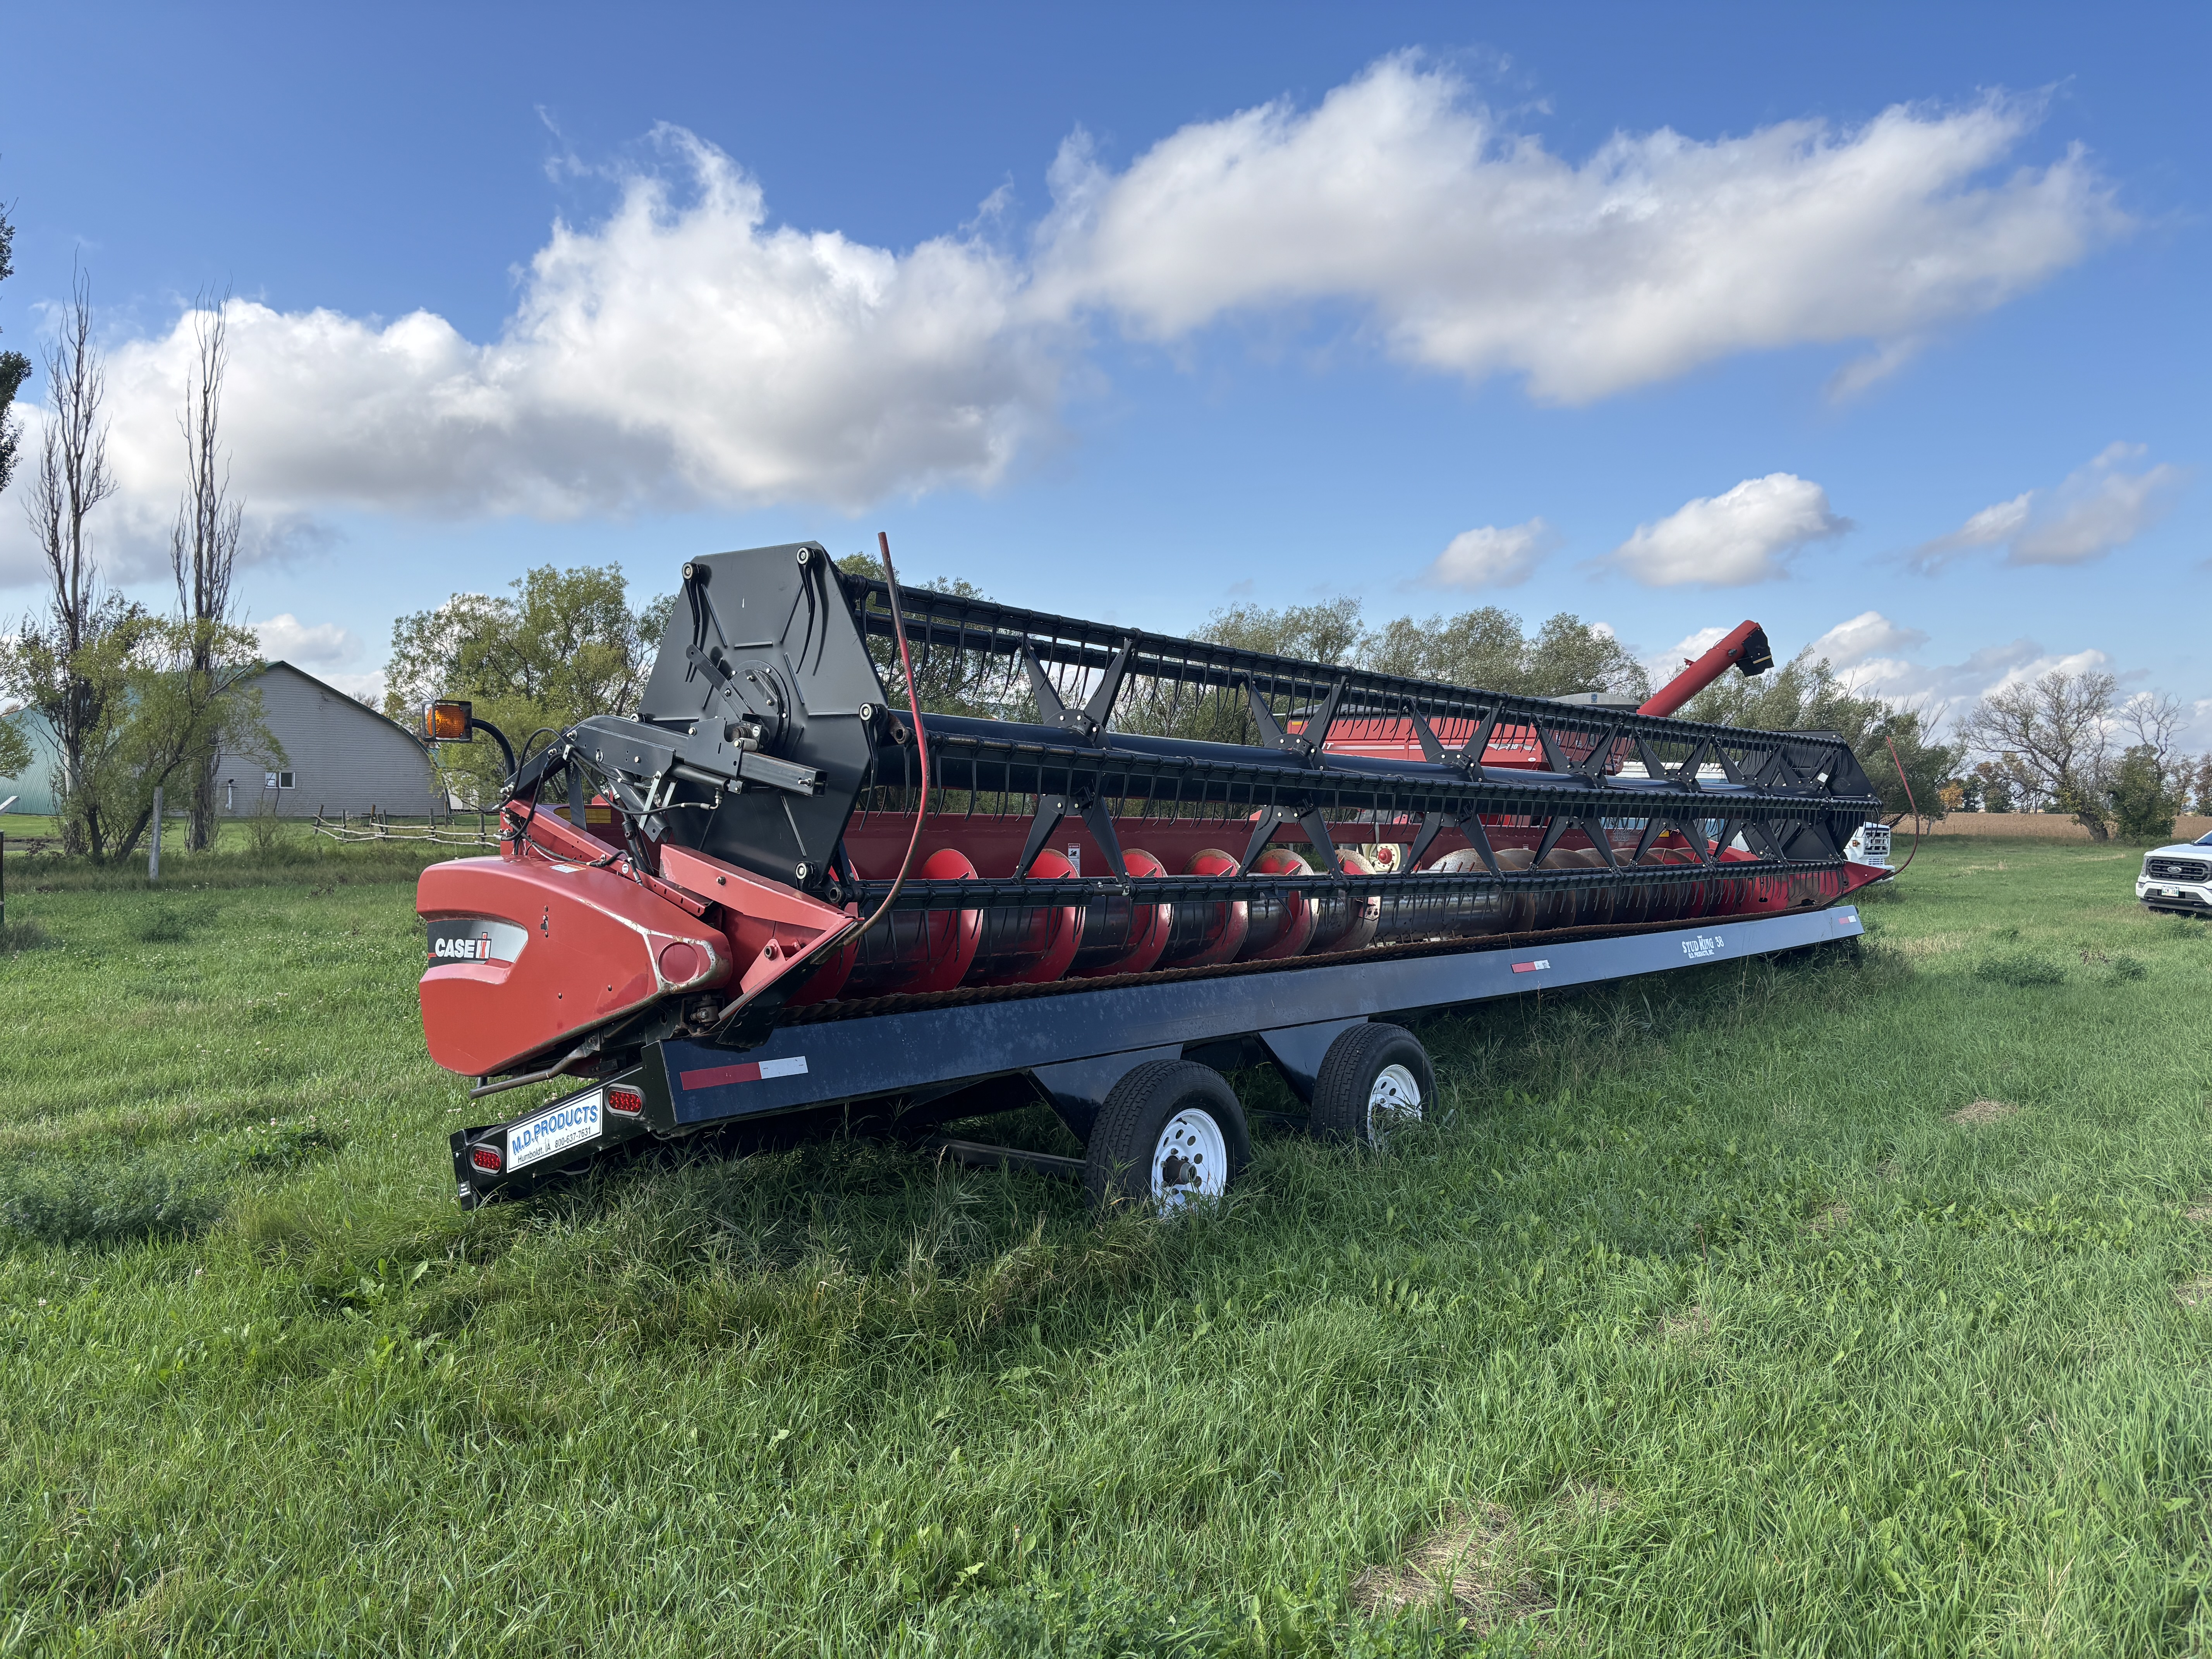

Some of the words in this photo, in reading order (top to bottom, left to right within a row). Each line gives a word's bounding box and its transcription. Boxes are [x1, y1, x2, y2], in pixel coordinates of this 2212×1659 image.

[1613, 829, 1630, 842] 2020
[435, 938, 476, 958] CASE
[1682, 940, 1699, 953] STUD
[1698, 938, 1714, 951] KING
[1715, 936, 1724, 948] 38
[545, 1143, 551, 1152] IA
[555, 1126, 591, 1148] 800-637-7631
